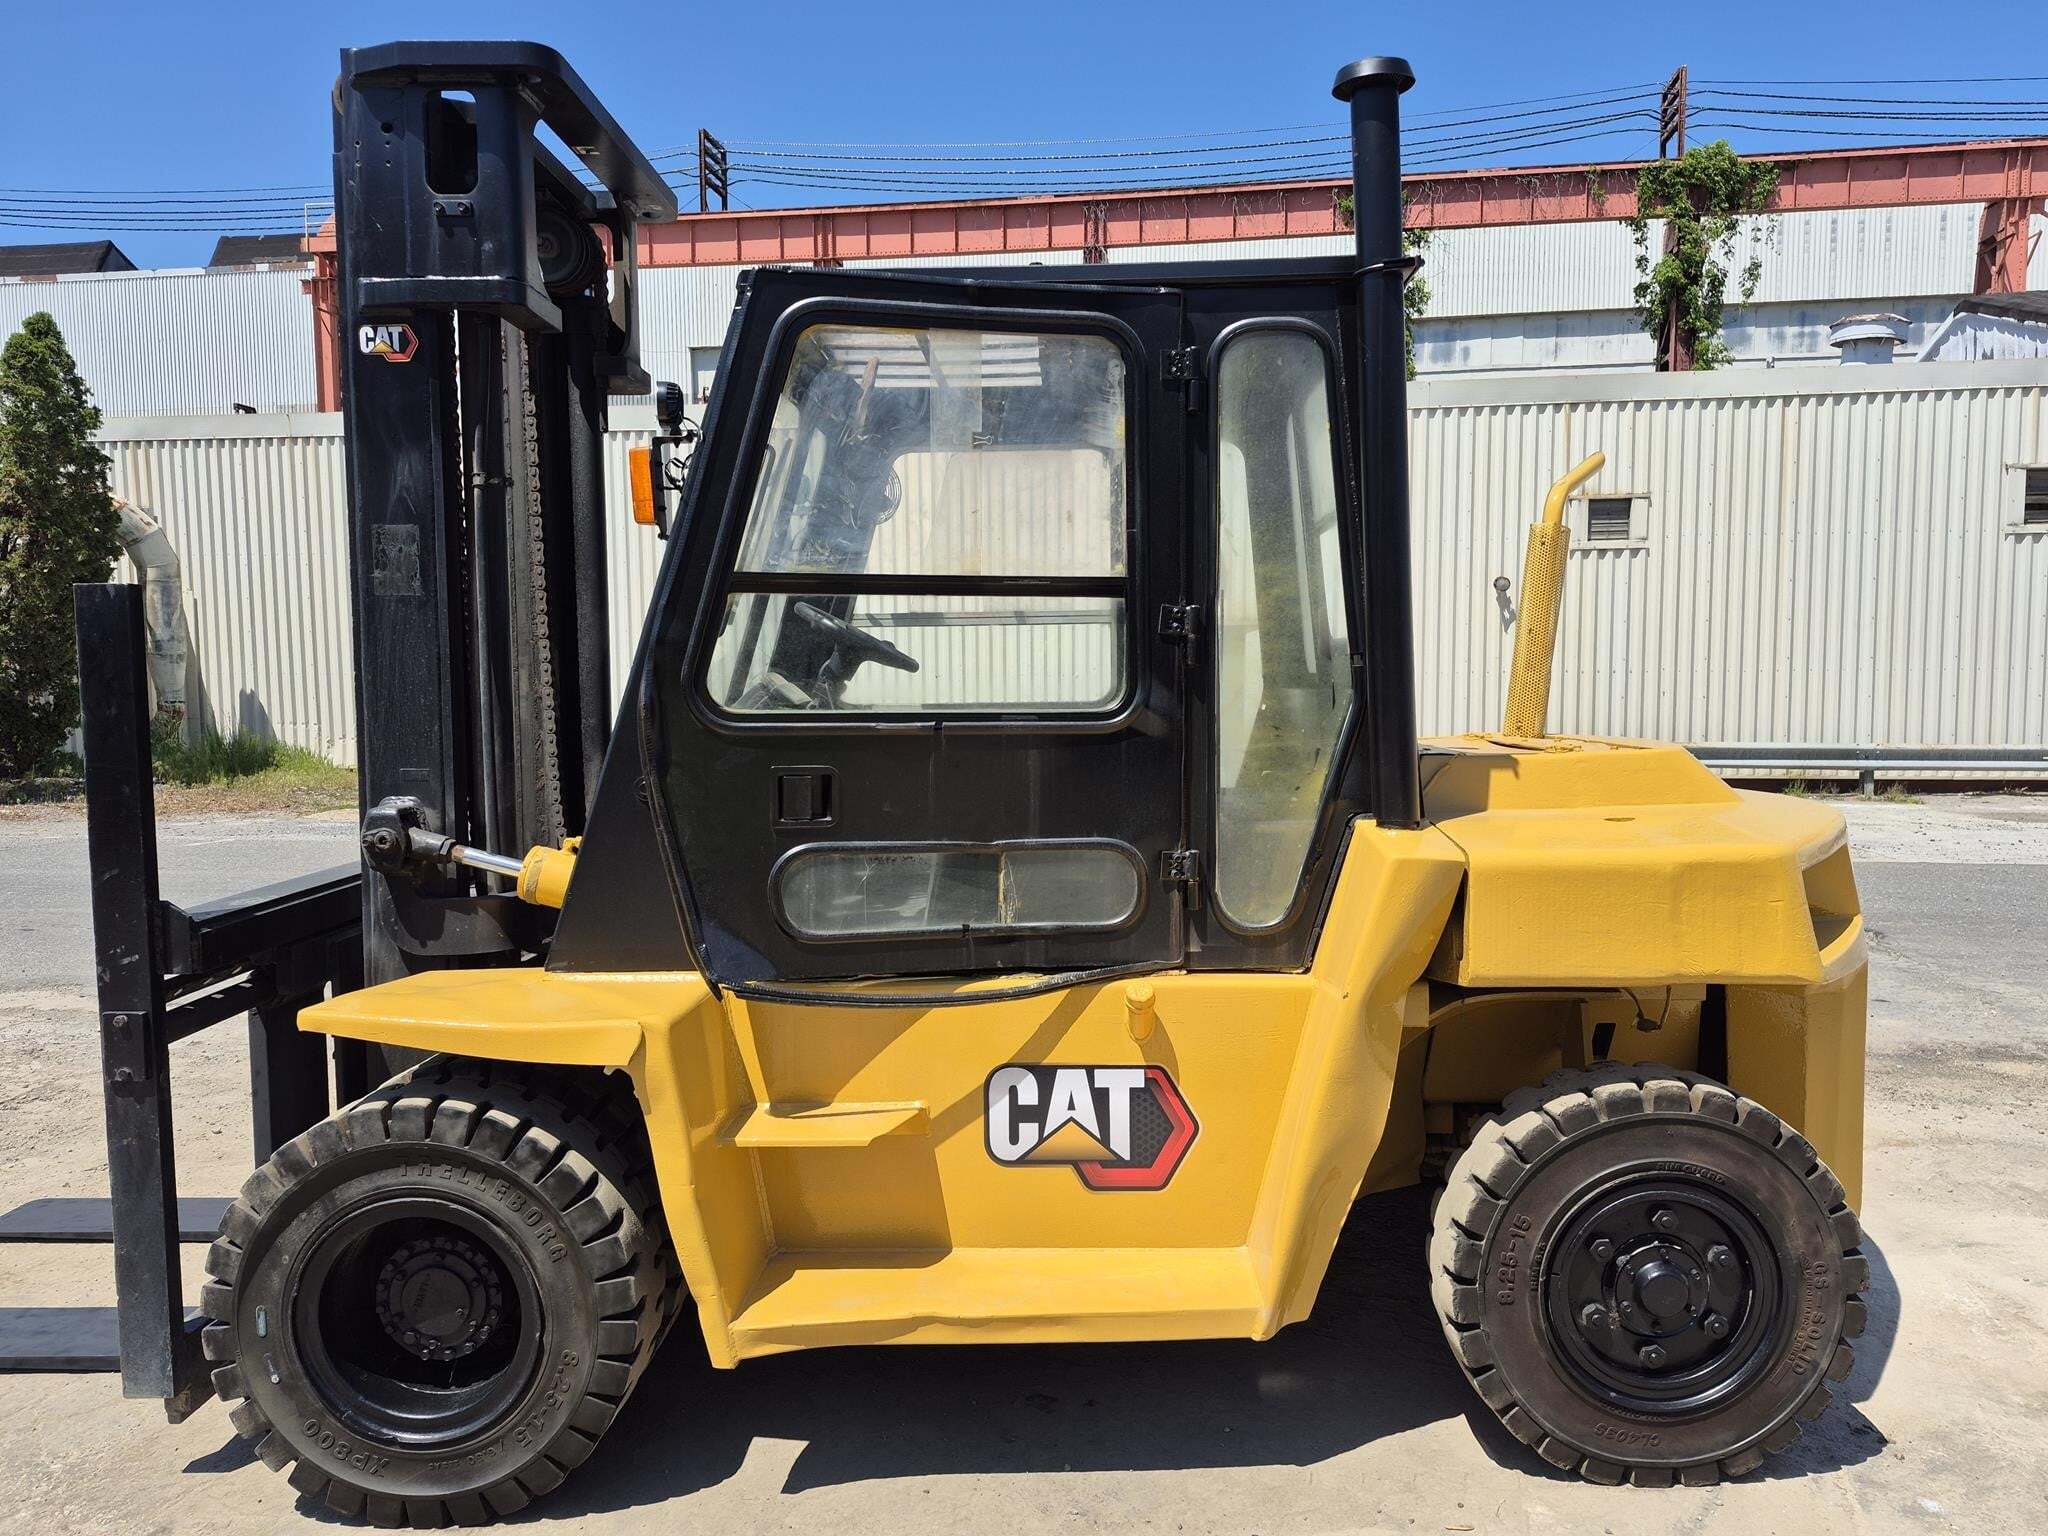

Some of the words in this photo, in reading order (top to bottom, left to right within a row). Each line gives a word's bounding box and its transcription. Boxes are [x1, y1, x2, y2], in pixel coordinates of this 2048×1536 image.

[359, 326, 403, 353] CAT
[988, 1067, 1145, 1161] CAT
[400, 1159, 568, 1264] TRELLEBORG
[516, 1349, 579, 1449] 8.25-15
